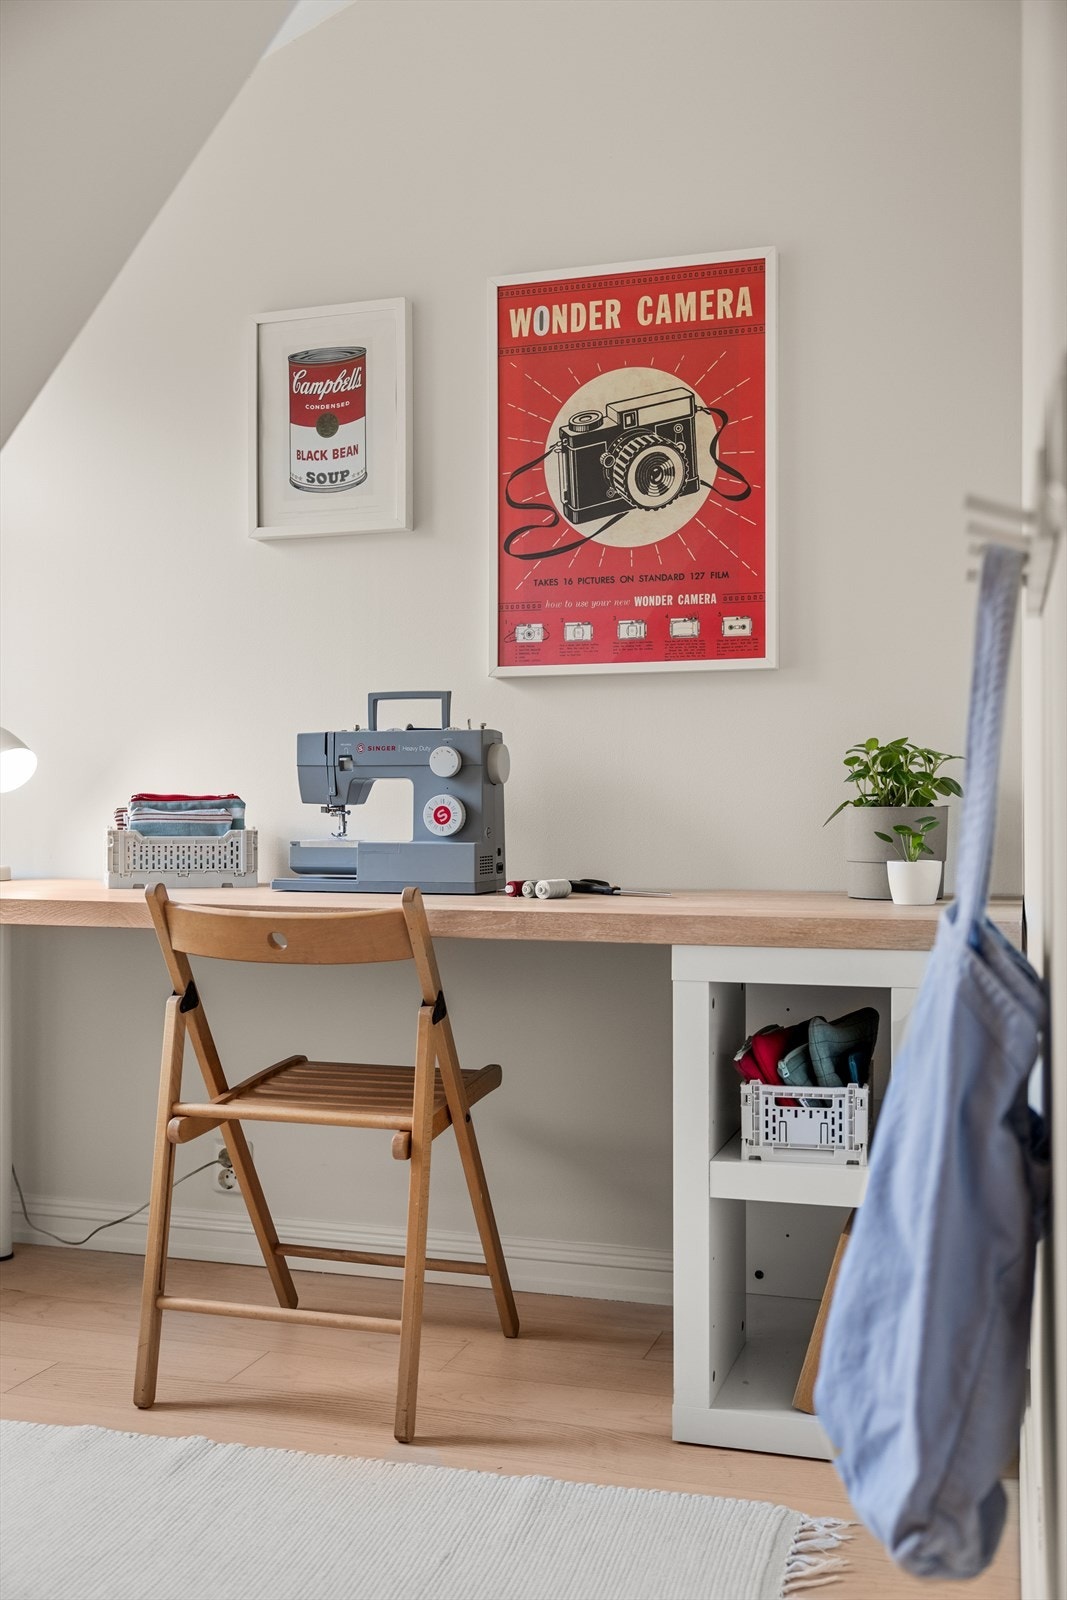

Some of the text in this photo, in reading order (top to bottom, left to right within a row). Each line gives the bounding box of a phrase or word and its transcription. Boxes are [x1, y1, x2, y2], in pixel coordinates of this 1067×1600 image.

[509, 286, 753, 338] WONDER CAMERA
[305, 401, 350, 409] CONDENSED
[296, 444, 359, 461] BLACK BEAN
[306, 469, 350, 484] SOUP
[534, 571, 730, 586] TAKES 16 PICTURES ON STANDARD 127 FILM
[545, 600, 562, 609] how
[565, 600, 573, 608] to
[576, 600, 589, 608] use
[592, 600, 611, 609] your
[634, 595, 673, 607] WONDER
[678, 593, 717, 605] CAMERA
[402, 745, 418, 753] Heavy
[419, 745, 431, 753] Duty
